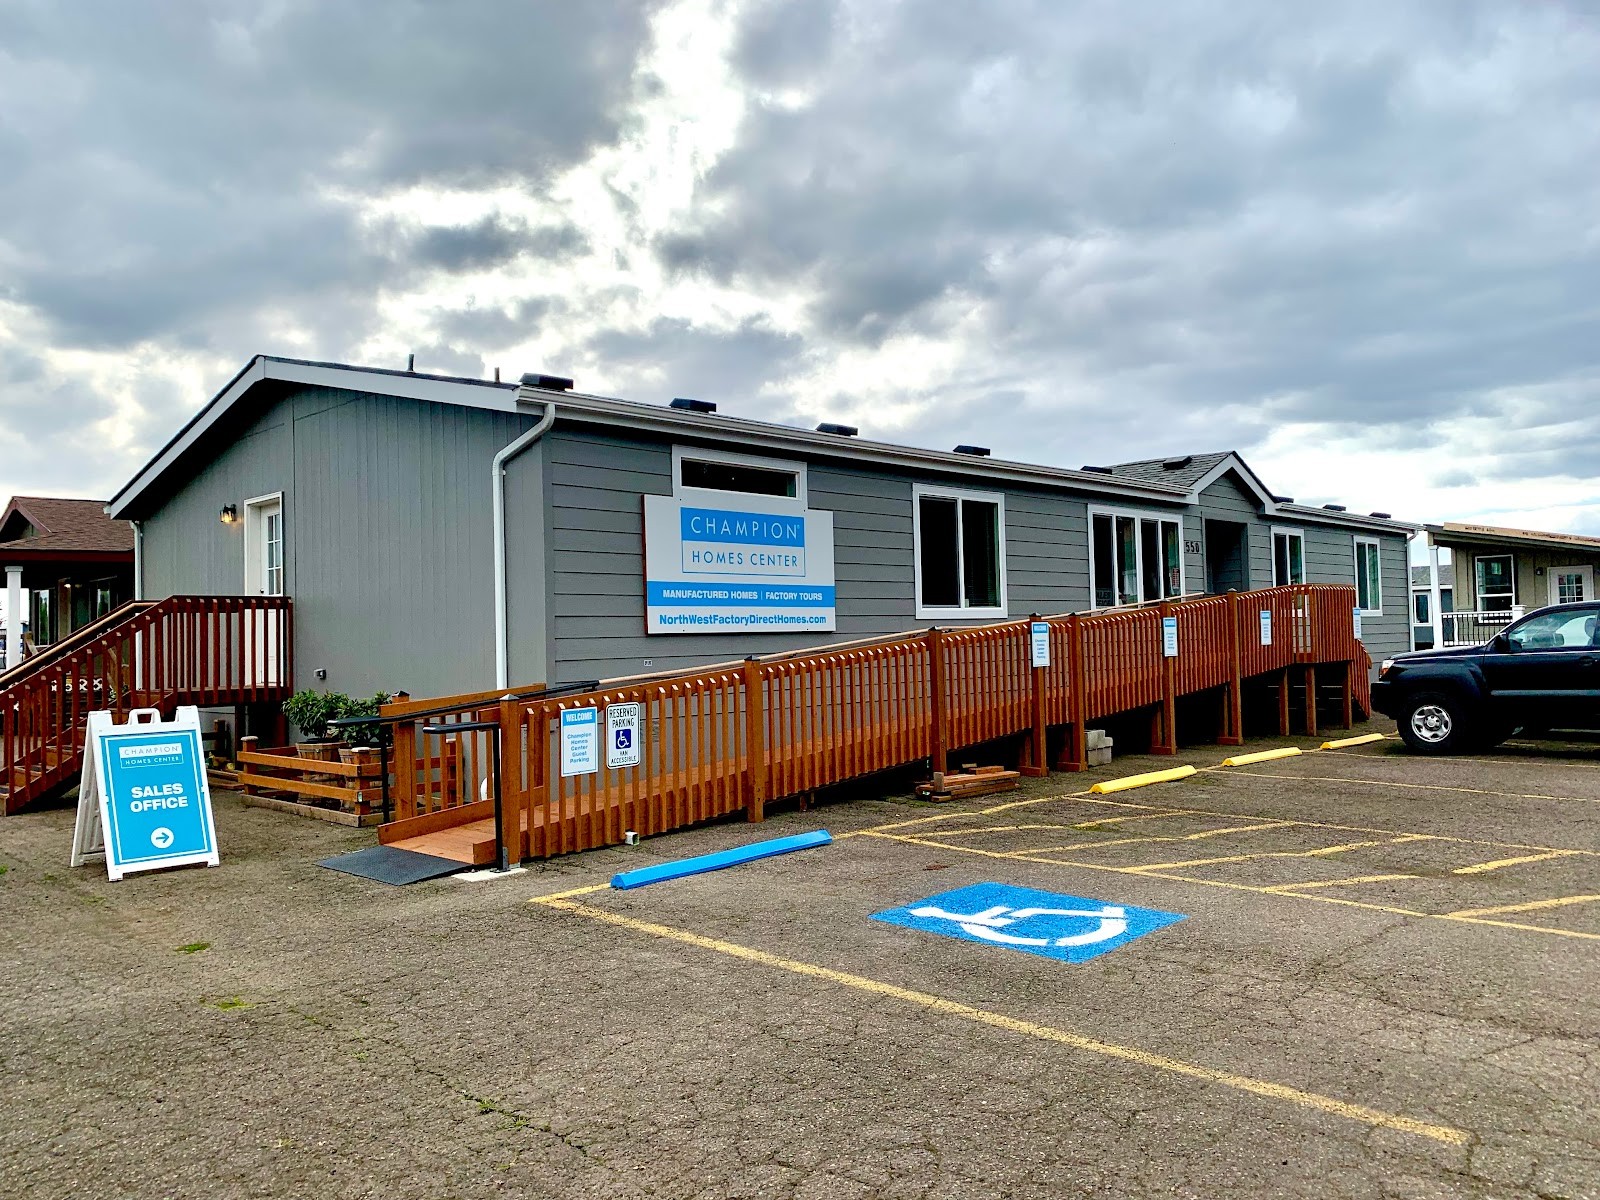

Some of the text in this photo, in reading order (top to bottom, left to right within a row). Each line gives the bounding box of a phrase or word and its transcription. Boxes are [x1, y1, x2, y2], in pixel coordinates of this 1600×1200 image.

[690, 516, 797, 540] CHAMPION
[692, 550, 798, 567] HOMES CENTER
[662, 589, 823, 601] MANUFACTURED HOMES FACTORY TOURS
[659, 614, 827, 626] NorthWestFactoryDirectHomes.com
[566, 712, 592, 722] WELCOME
[609, 706, 637, 719] RESERVED
[612, 717, 635, 729] PARKING
[124, 746, 178, 755] CHAMPION
[611, 756, 636, 764] ACCESSIBLE
[131, 783, 184, 799] SALES
[130, 796, 189, 813] OFFICE
